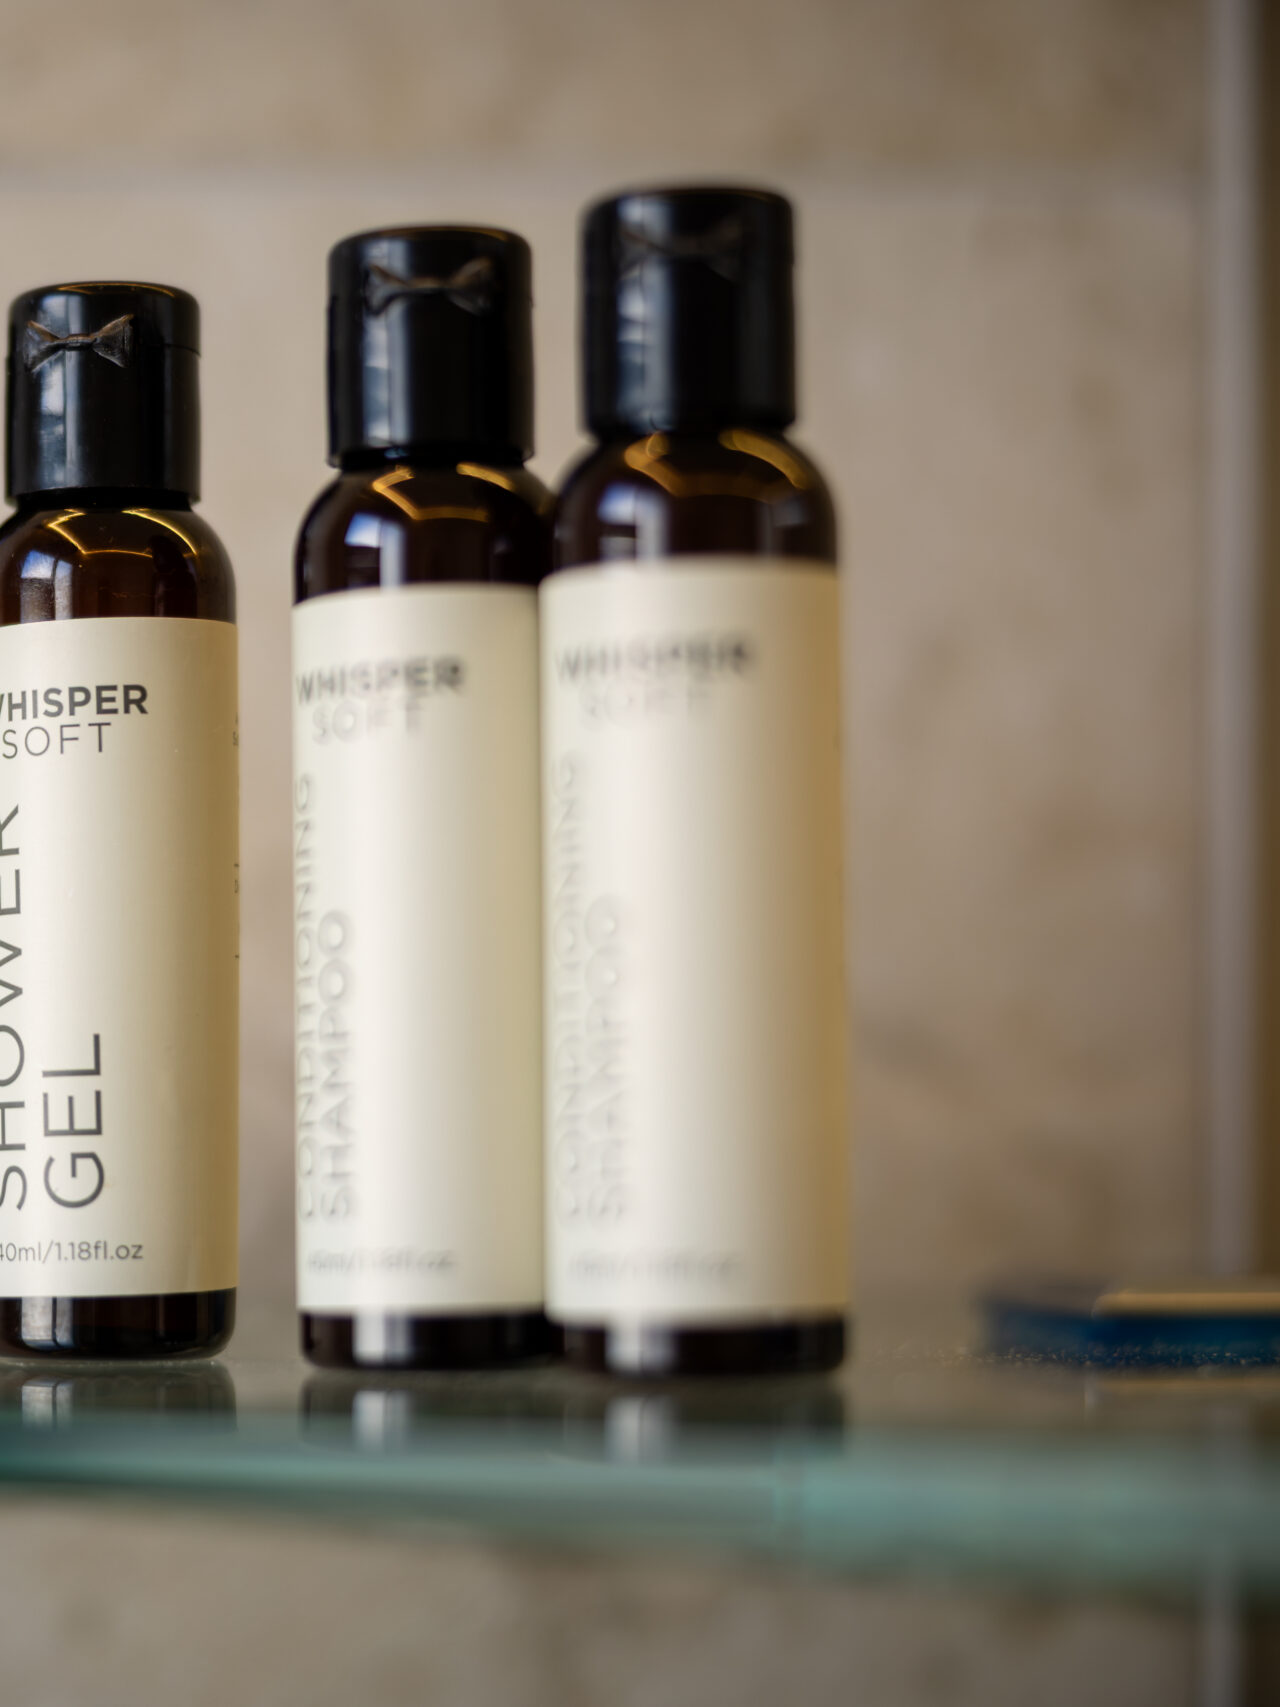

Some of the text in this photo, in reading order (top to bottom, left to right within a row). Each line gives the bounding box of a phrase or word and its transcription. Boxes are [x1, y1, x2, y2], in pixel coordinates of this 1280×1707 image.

[295, 655, 465, 704] WHISPER
[1, 722, 112, 759] SOFT
[312, 694, 428, 744] SOFT
[318, 908, 356, 1224] SHAMPOO
[42, 1033, 105, 1209] GEL
